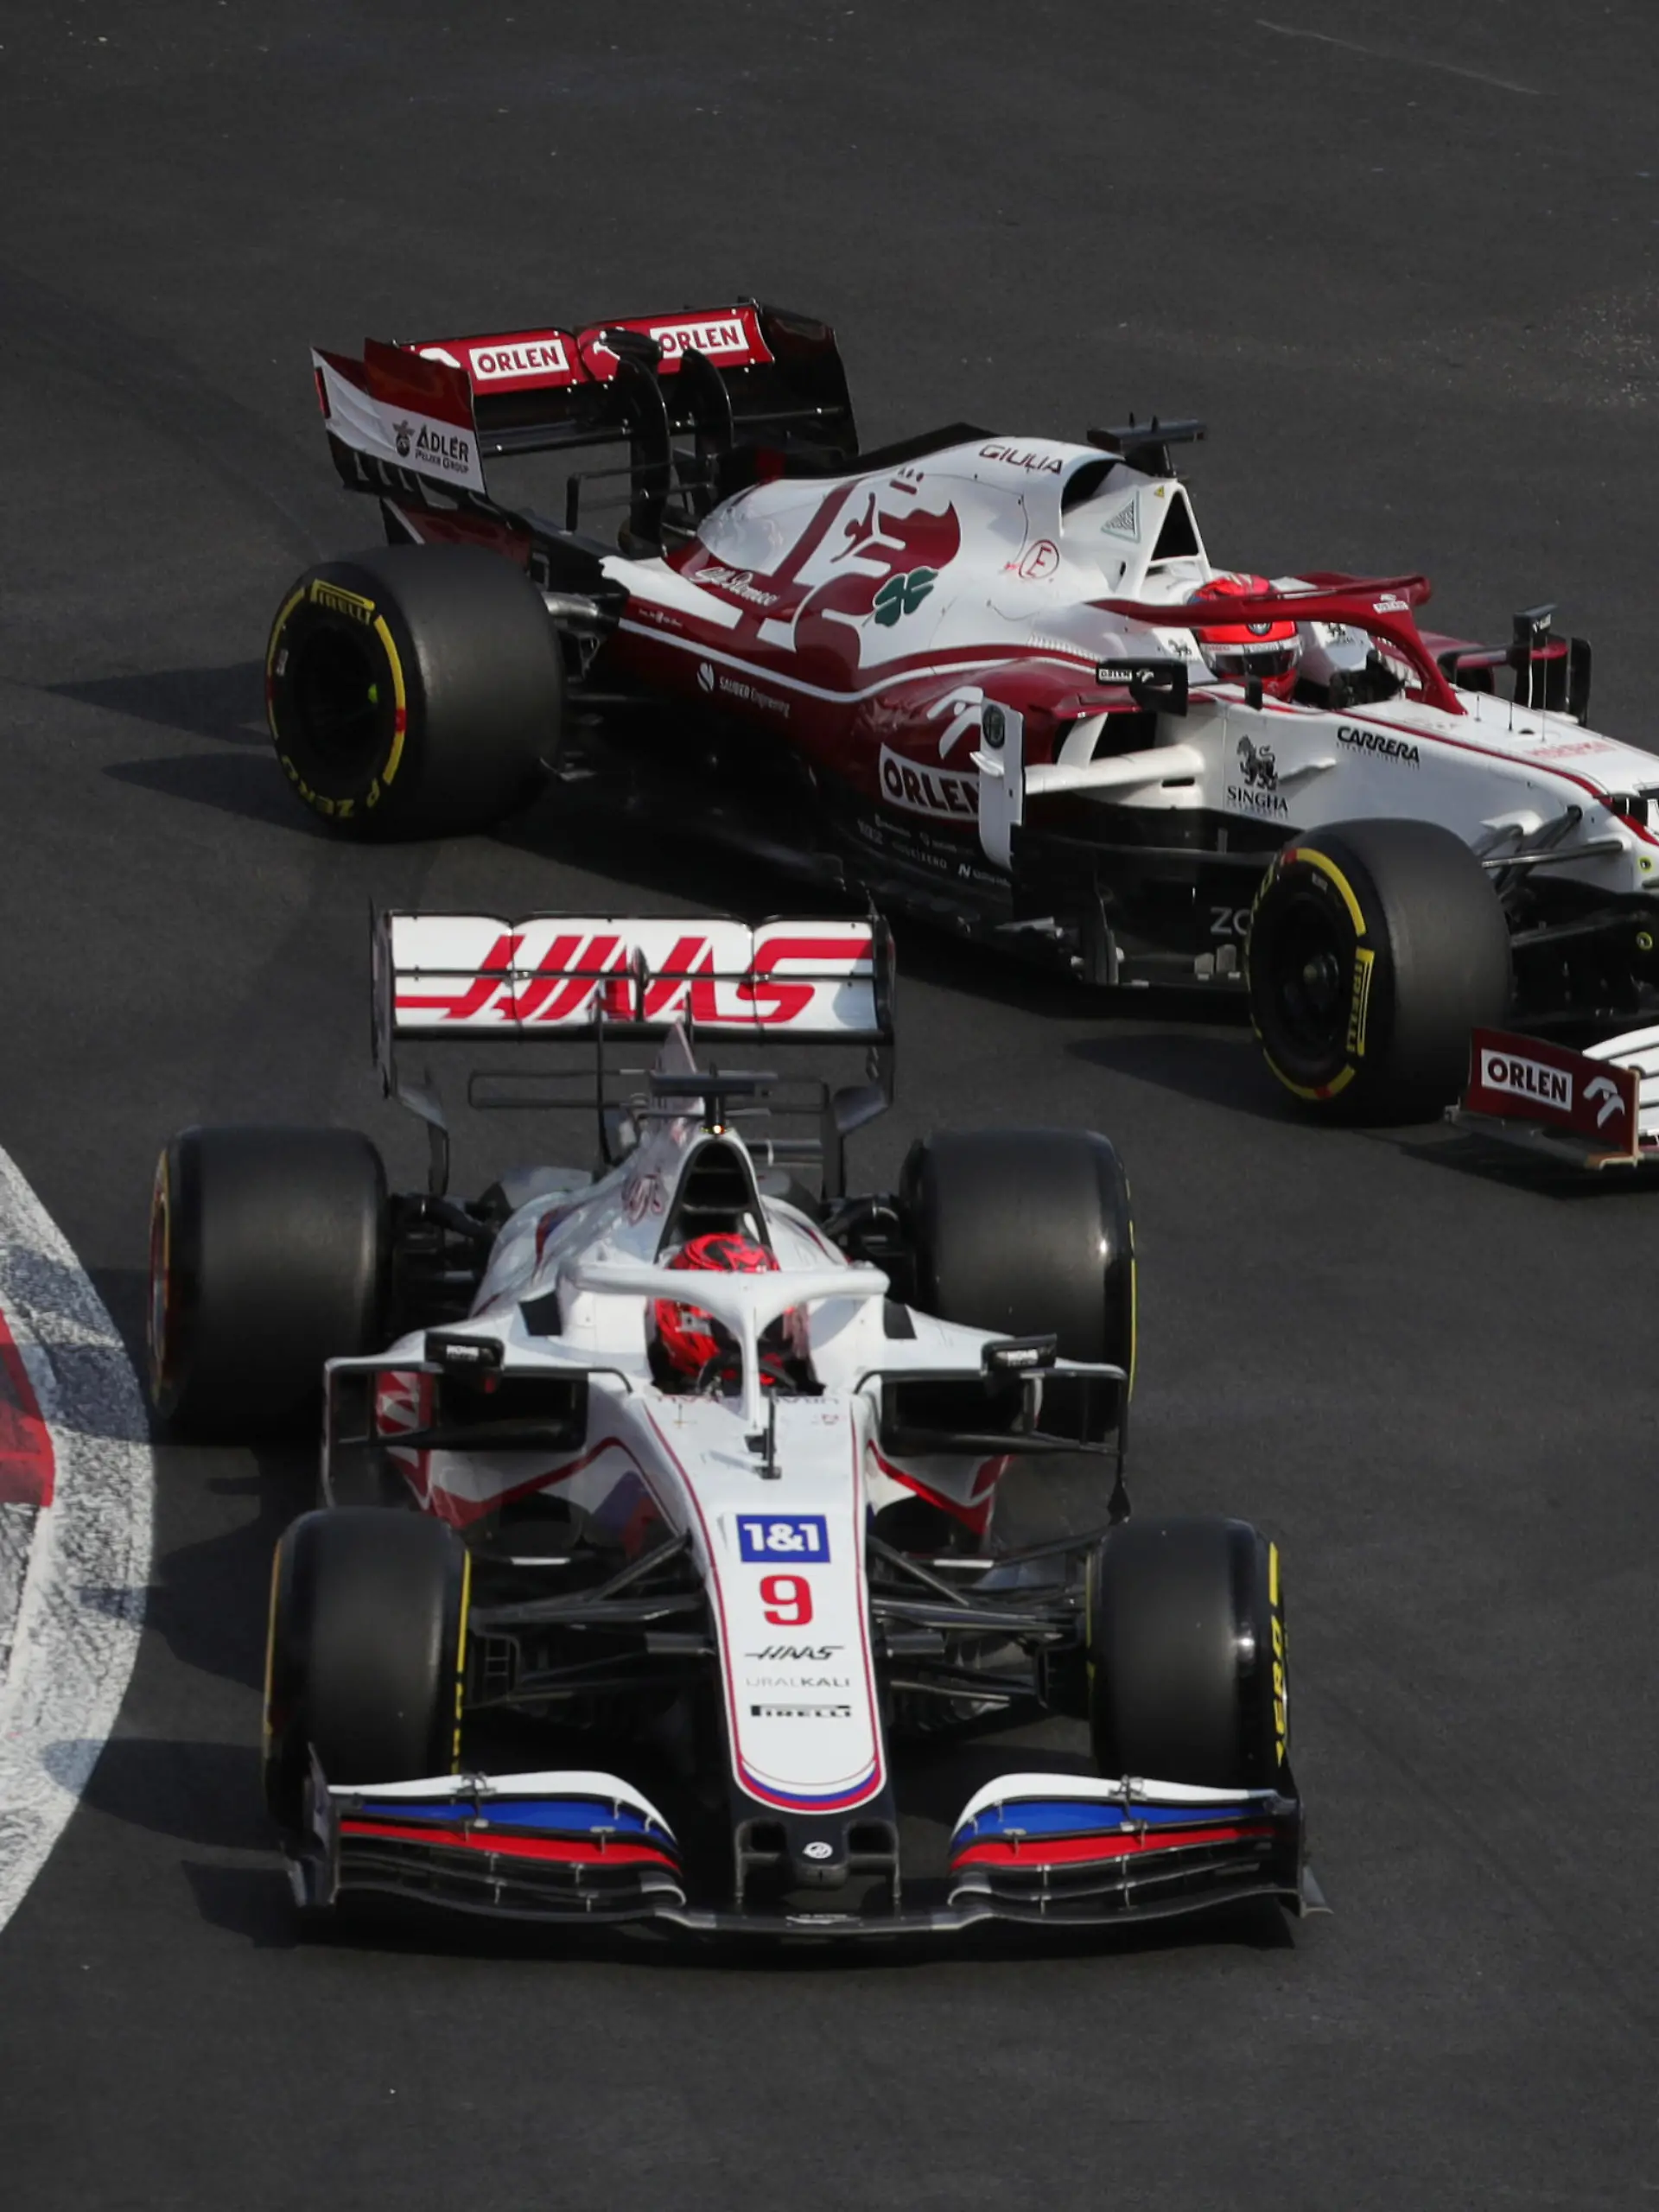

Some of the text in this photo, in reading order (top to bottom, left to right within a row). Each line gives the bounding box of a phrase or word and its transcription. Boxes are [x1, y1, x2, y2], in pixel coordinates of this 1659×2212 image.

[659, 327, 741, 353] ORLEN
[477, 348, 560, 373] ORLEN
[416, 423, 469, 462] ADLER
[979, 444, 1063, 475] GIULIA
[1026, 545, 1052, 578] E
[309, 579, 375, 626] PIRELLI
[1337, 726, 1420, 764] CARRERA
[1228, 785, 1287, 812] SINGHA
[395, 935, 874, 1022] HAAS
[1487, 1057, 1567, 1103] ORLEN
[743, 1523, 820, 1551] 1&1
[760, 1574, 814, 1626] 9
[745, 1645, 845, 1660] HAAS
[746, 1677, 849, 1688] URALKALI
[750, 1704, 851, 1719] PIRELLI
